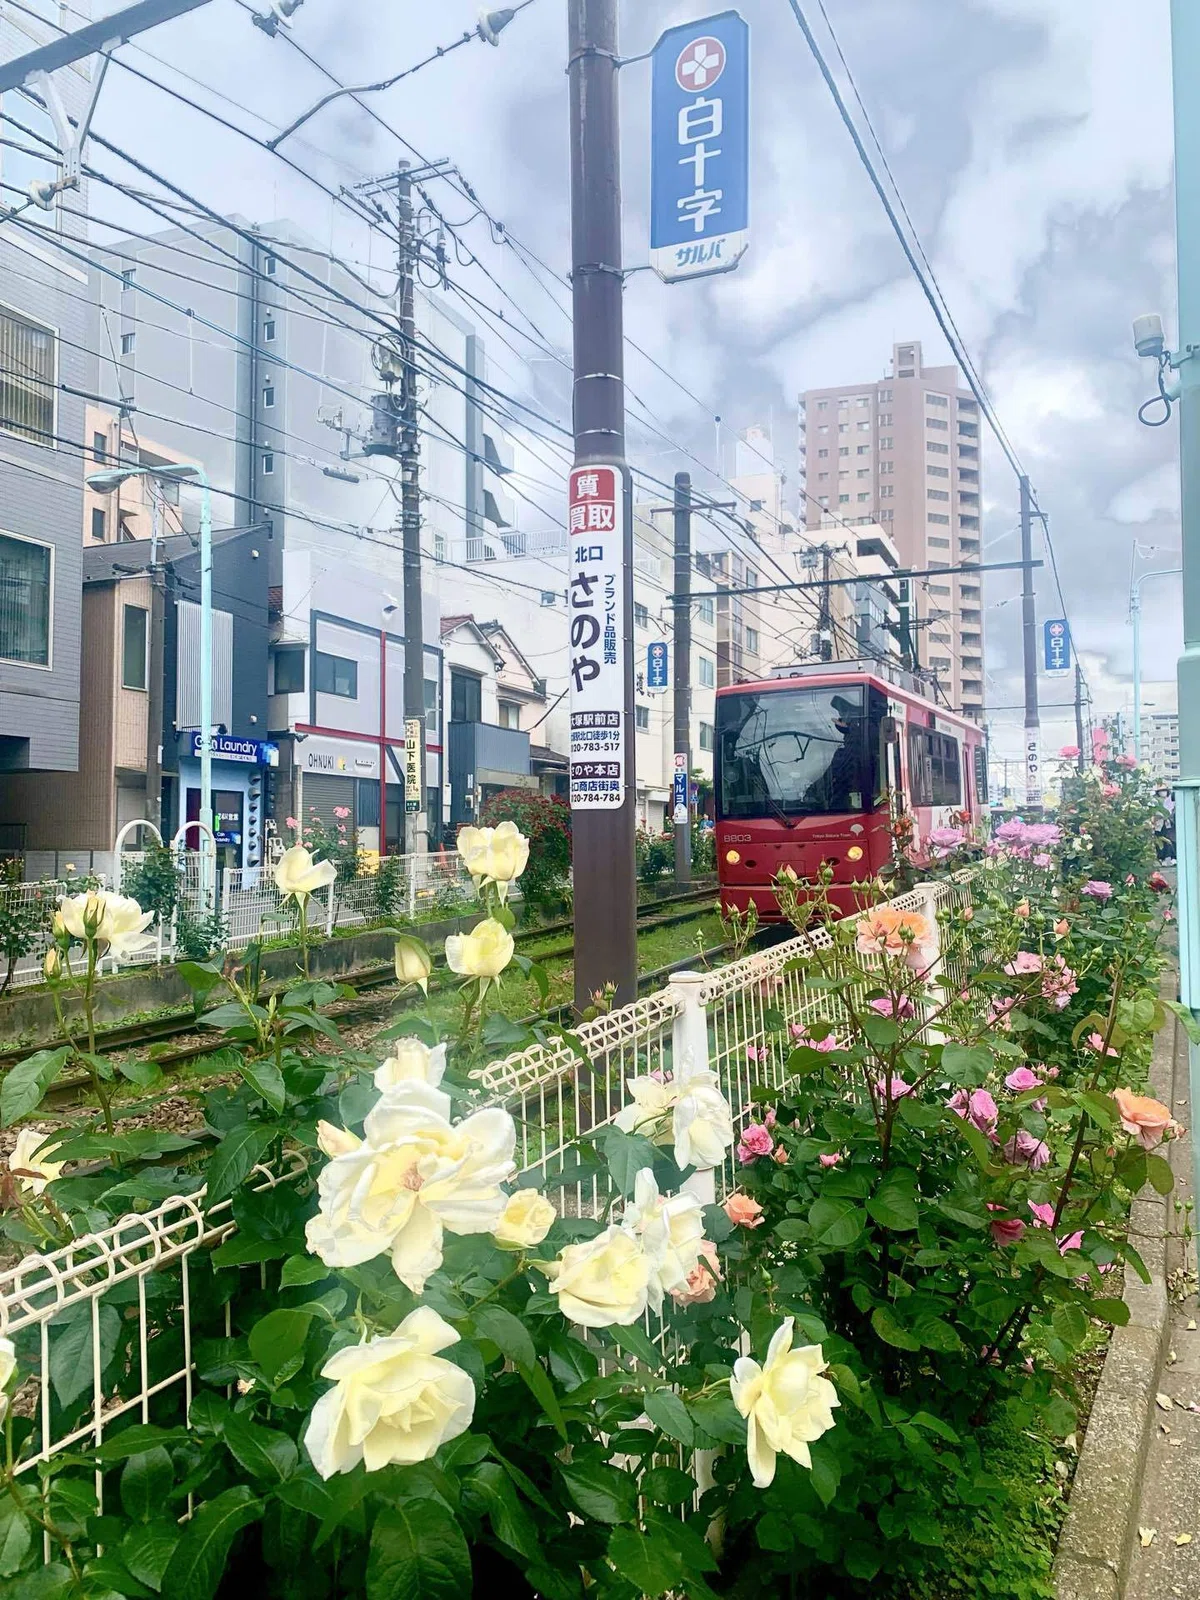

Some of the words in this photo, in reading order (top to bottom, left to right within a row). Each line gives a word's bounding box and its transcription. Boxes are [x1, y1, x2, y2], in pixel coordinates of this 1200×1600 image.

[677, 96, 723, 233] 白十字
[675, 238, 726, 268] サルバ
[576, 474, 600, 499] 質
[570, 504, 613, 533] 買取
[574, 545, 604, 564] 北口
[570, 571, 601, 693] さのや
[604, 573, 617, 665] ブランド品販売
[1050, 636, 1064, 669] 白十字
[652, 657, 663, 686] 白十字
[194, 734, 218, 751] Cn
[219, 737, 258, 756] Laundry
[308, 753, 334, 769] OHNUKI
[406, 739, 416, 785] 山下医院
[675, 774, 685, 803] マルヨ
[723, 833, 752, 843] 8803
